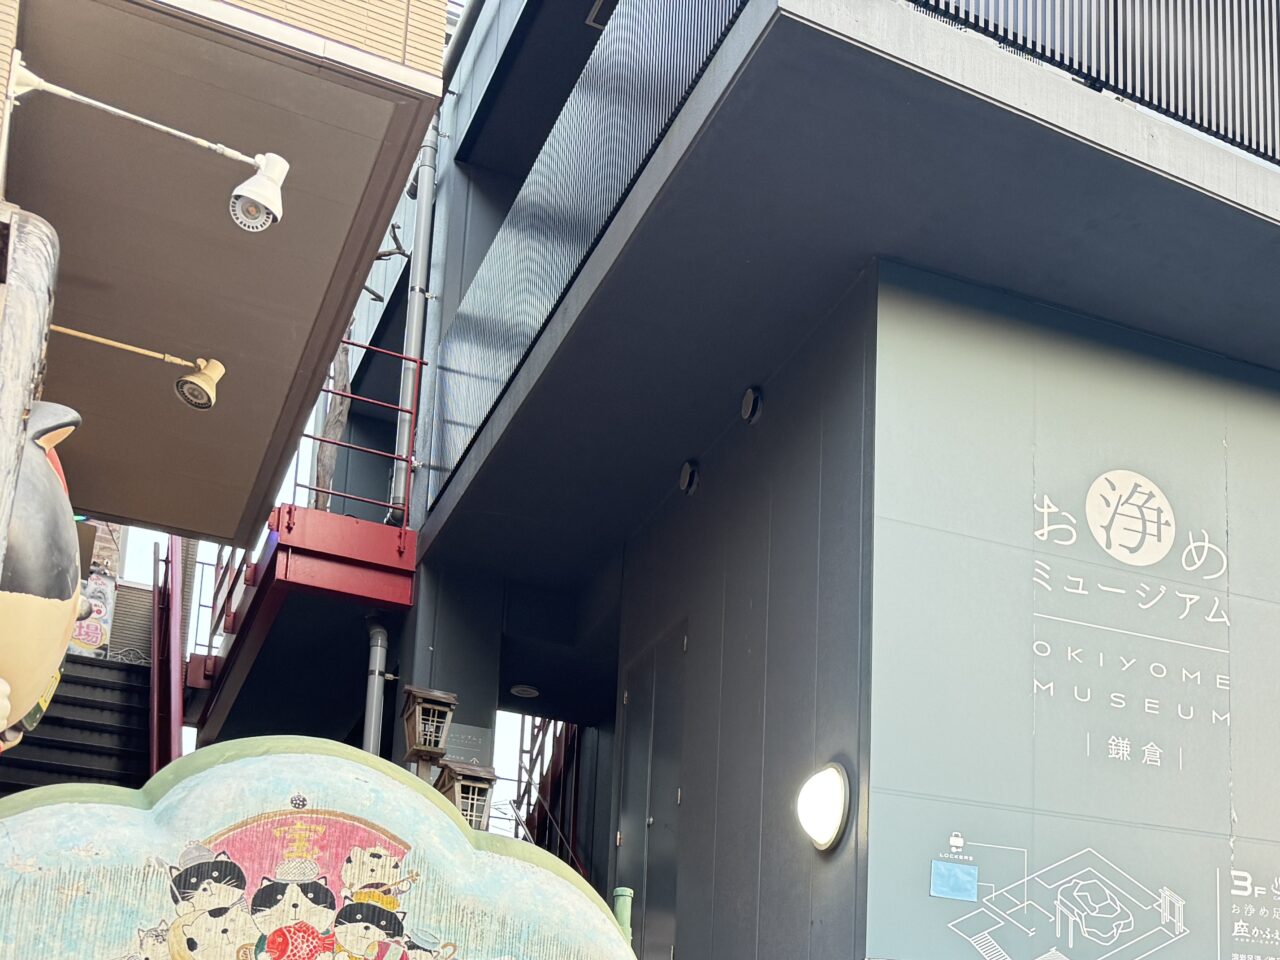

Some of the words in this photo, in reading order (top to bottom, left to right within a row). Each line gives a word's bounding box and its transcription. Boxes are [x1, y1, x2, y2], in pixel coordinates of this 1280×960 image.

[1034, 475, 1228, 580] お浄め
[1032, 559, 1230, 626] ミュージアム
[1032, 640, 1230, 689] OKIYOME
[1032, 679, 1230, 727] MUSEUM
[1107, 735, 1163, 767] 鎌倉
[938, 852, 974, 861] LOCKERS
[1230, 869, 1267, 898] 3F
